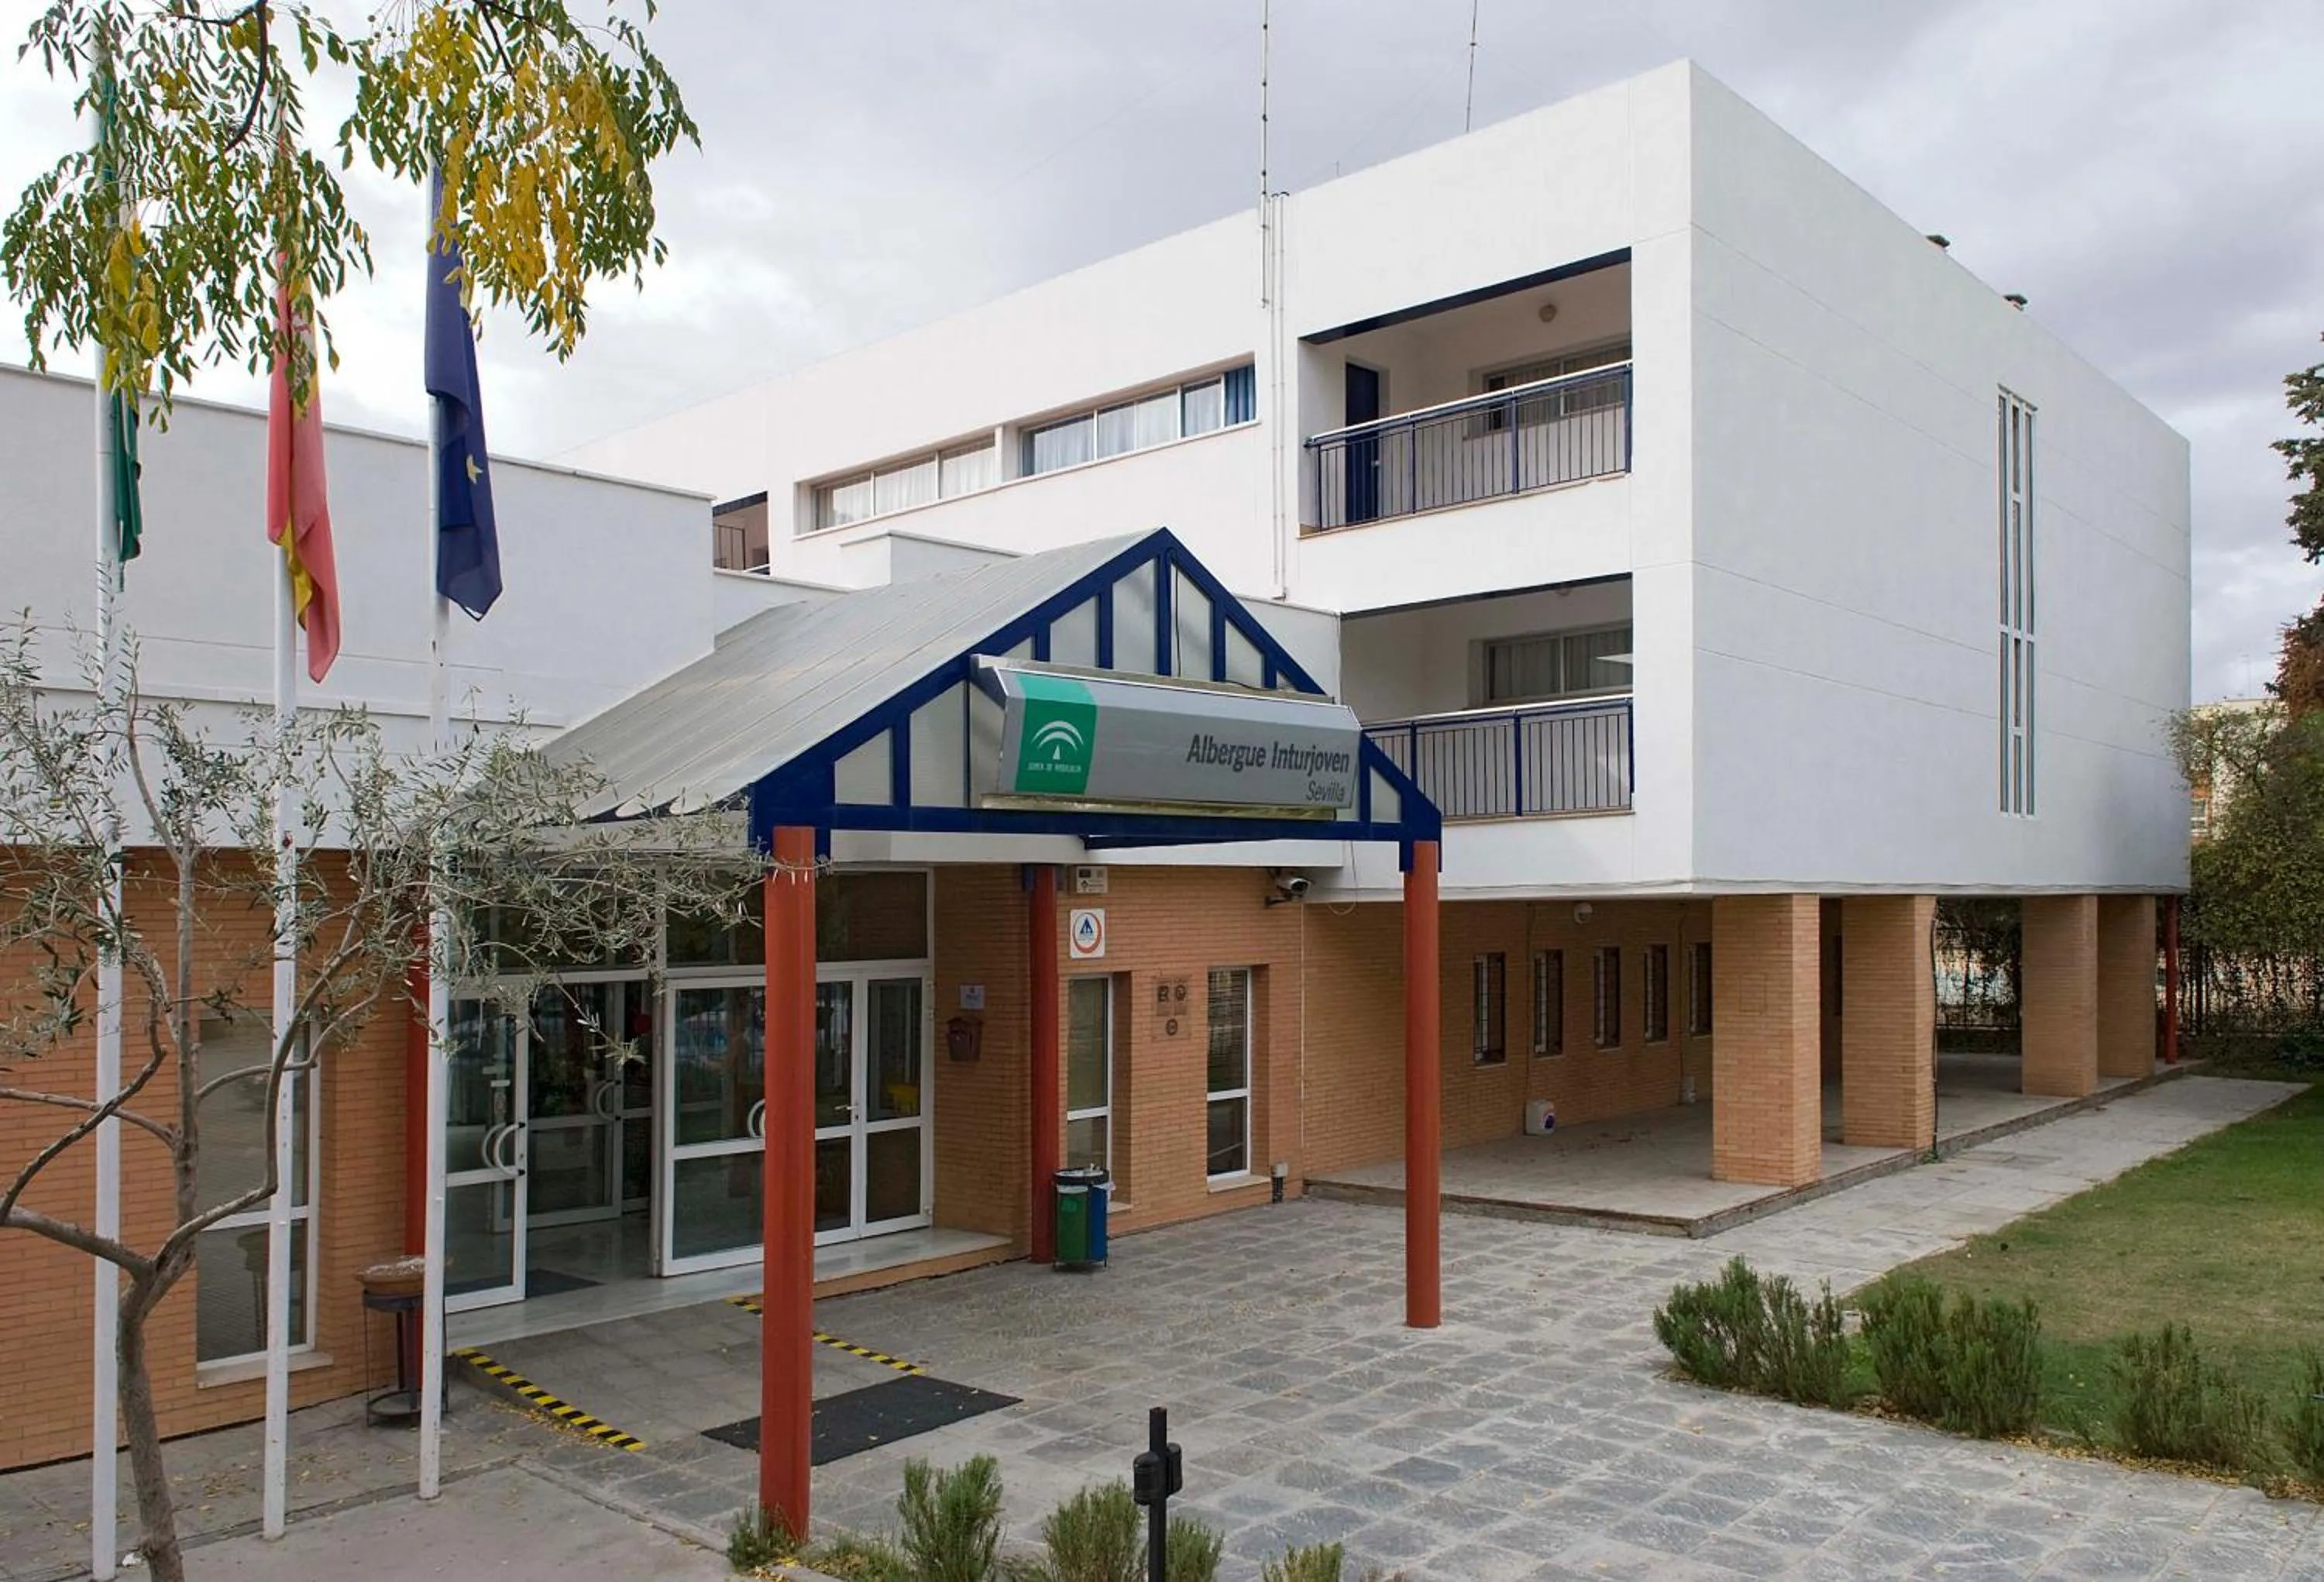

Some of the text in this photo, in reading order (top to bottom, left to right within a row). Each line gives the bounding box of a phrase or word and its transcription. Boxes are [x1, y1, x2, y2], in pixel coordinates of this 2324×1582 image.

[1186, 734, 1350, 776] Albergue Inturjoven
[1306, 780, 1346, 803] Sevilla
